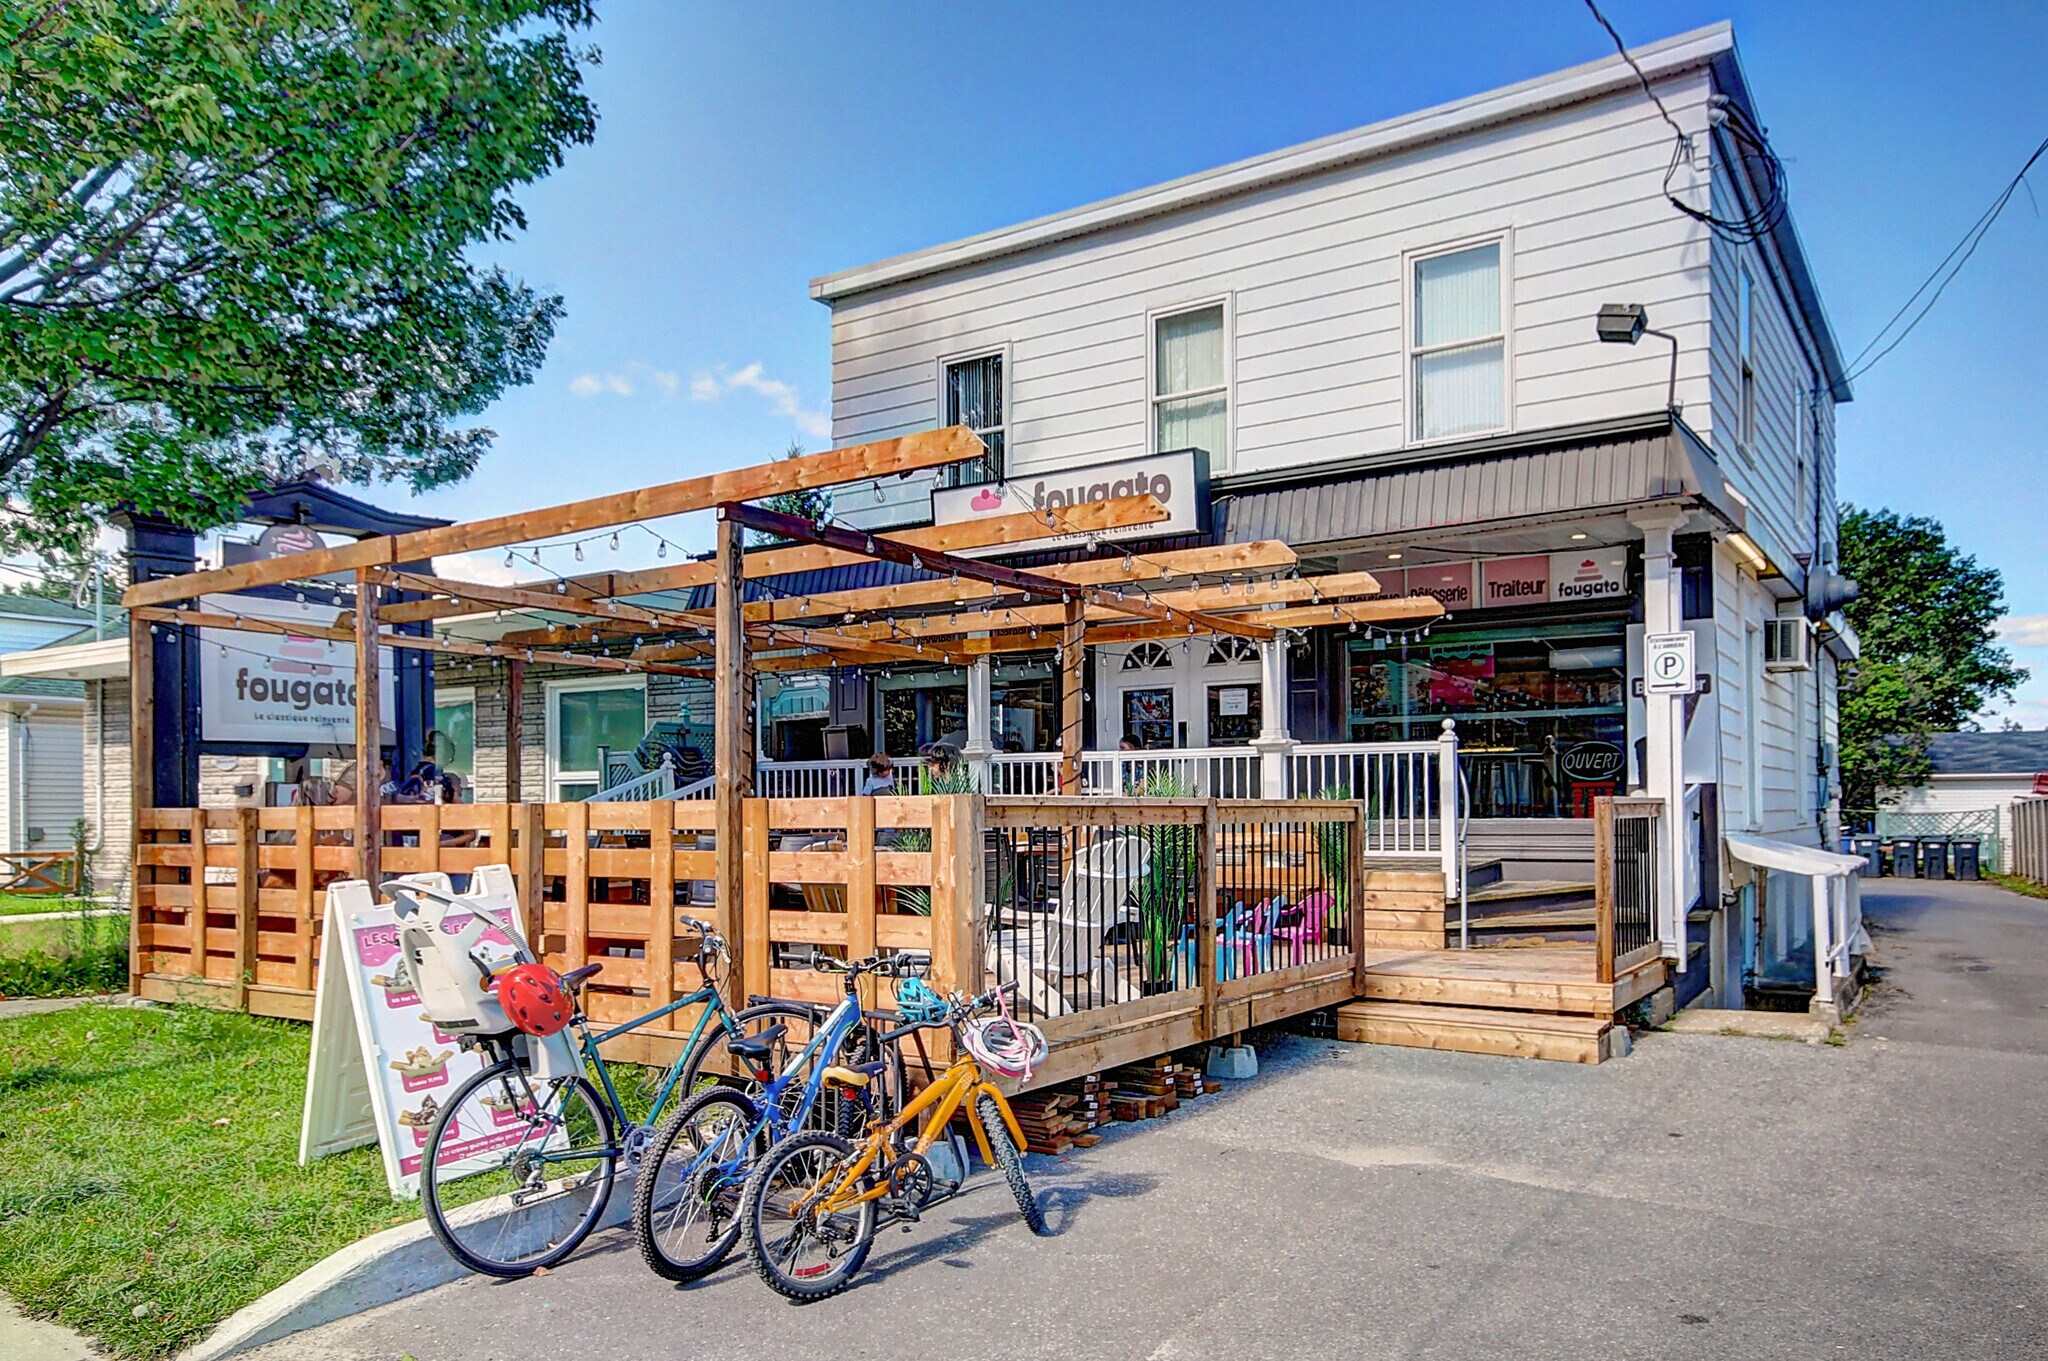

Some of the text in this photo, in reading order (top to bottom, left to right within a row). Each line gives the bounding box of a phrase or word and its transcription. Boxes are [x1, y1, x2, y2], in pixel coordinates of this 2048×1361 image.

[1488, 579, 1546, 598] Traiteur
[1559, 579, 1619, 598] fougato
[1664, 656, 1676, 675] P
[1564, 752, 1620, 769] OUVERT
[363, 932, 389, 948] LES
